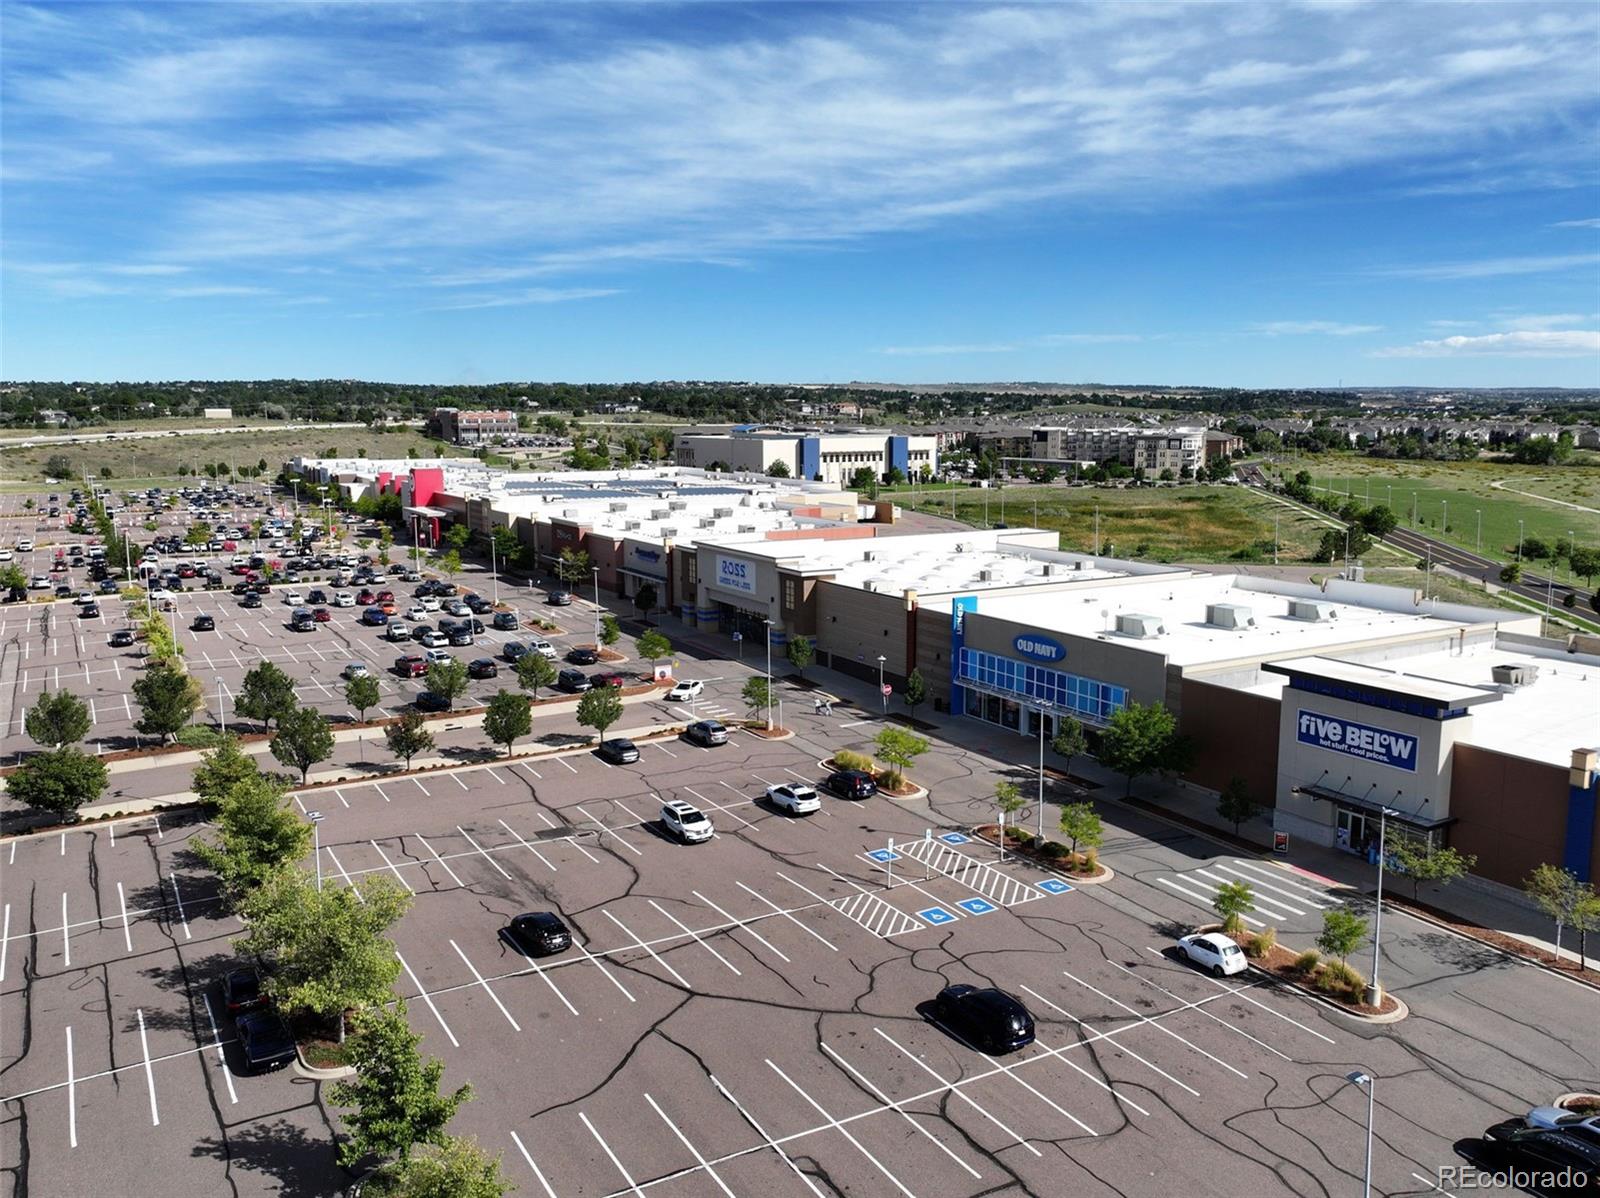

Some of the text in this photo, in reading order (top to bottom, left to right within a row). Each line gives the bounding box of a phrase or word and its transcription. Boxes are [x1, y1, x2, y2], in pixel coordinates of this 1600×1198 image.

[1017, 639, 1057, 658] OLD NAVY
[1319, 738, 1331, 747] hot
[1350, 747, 1365, 756] cool
